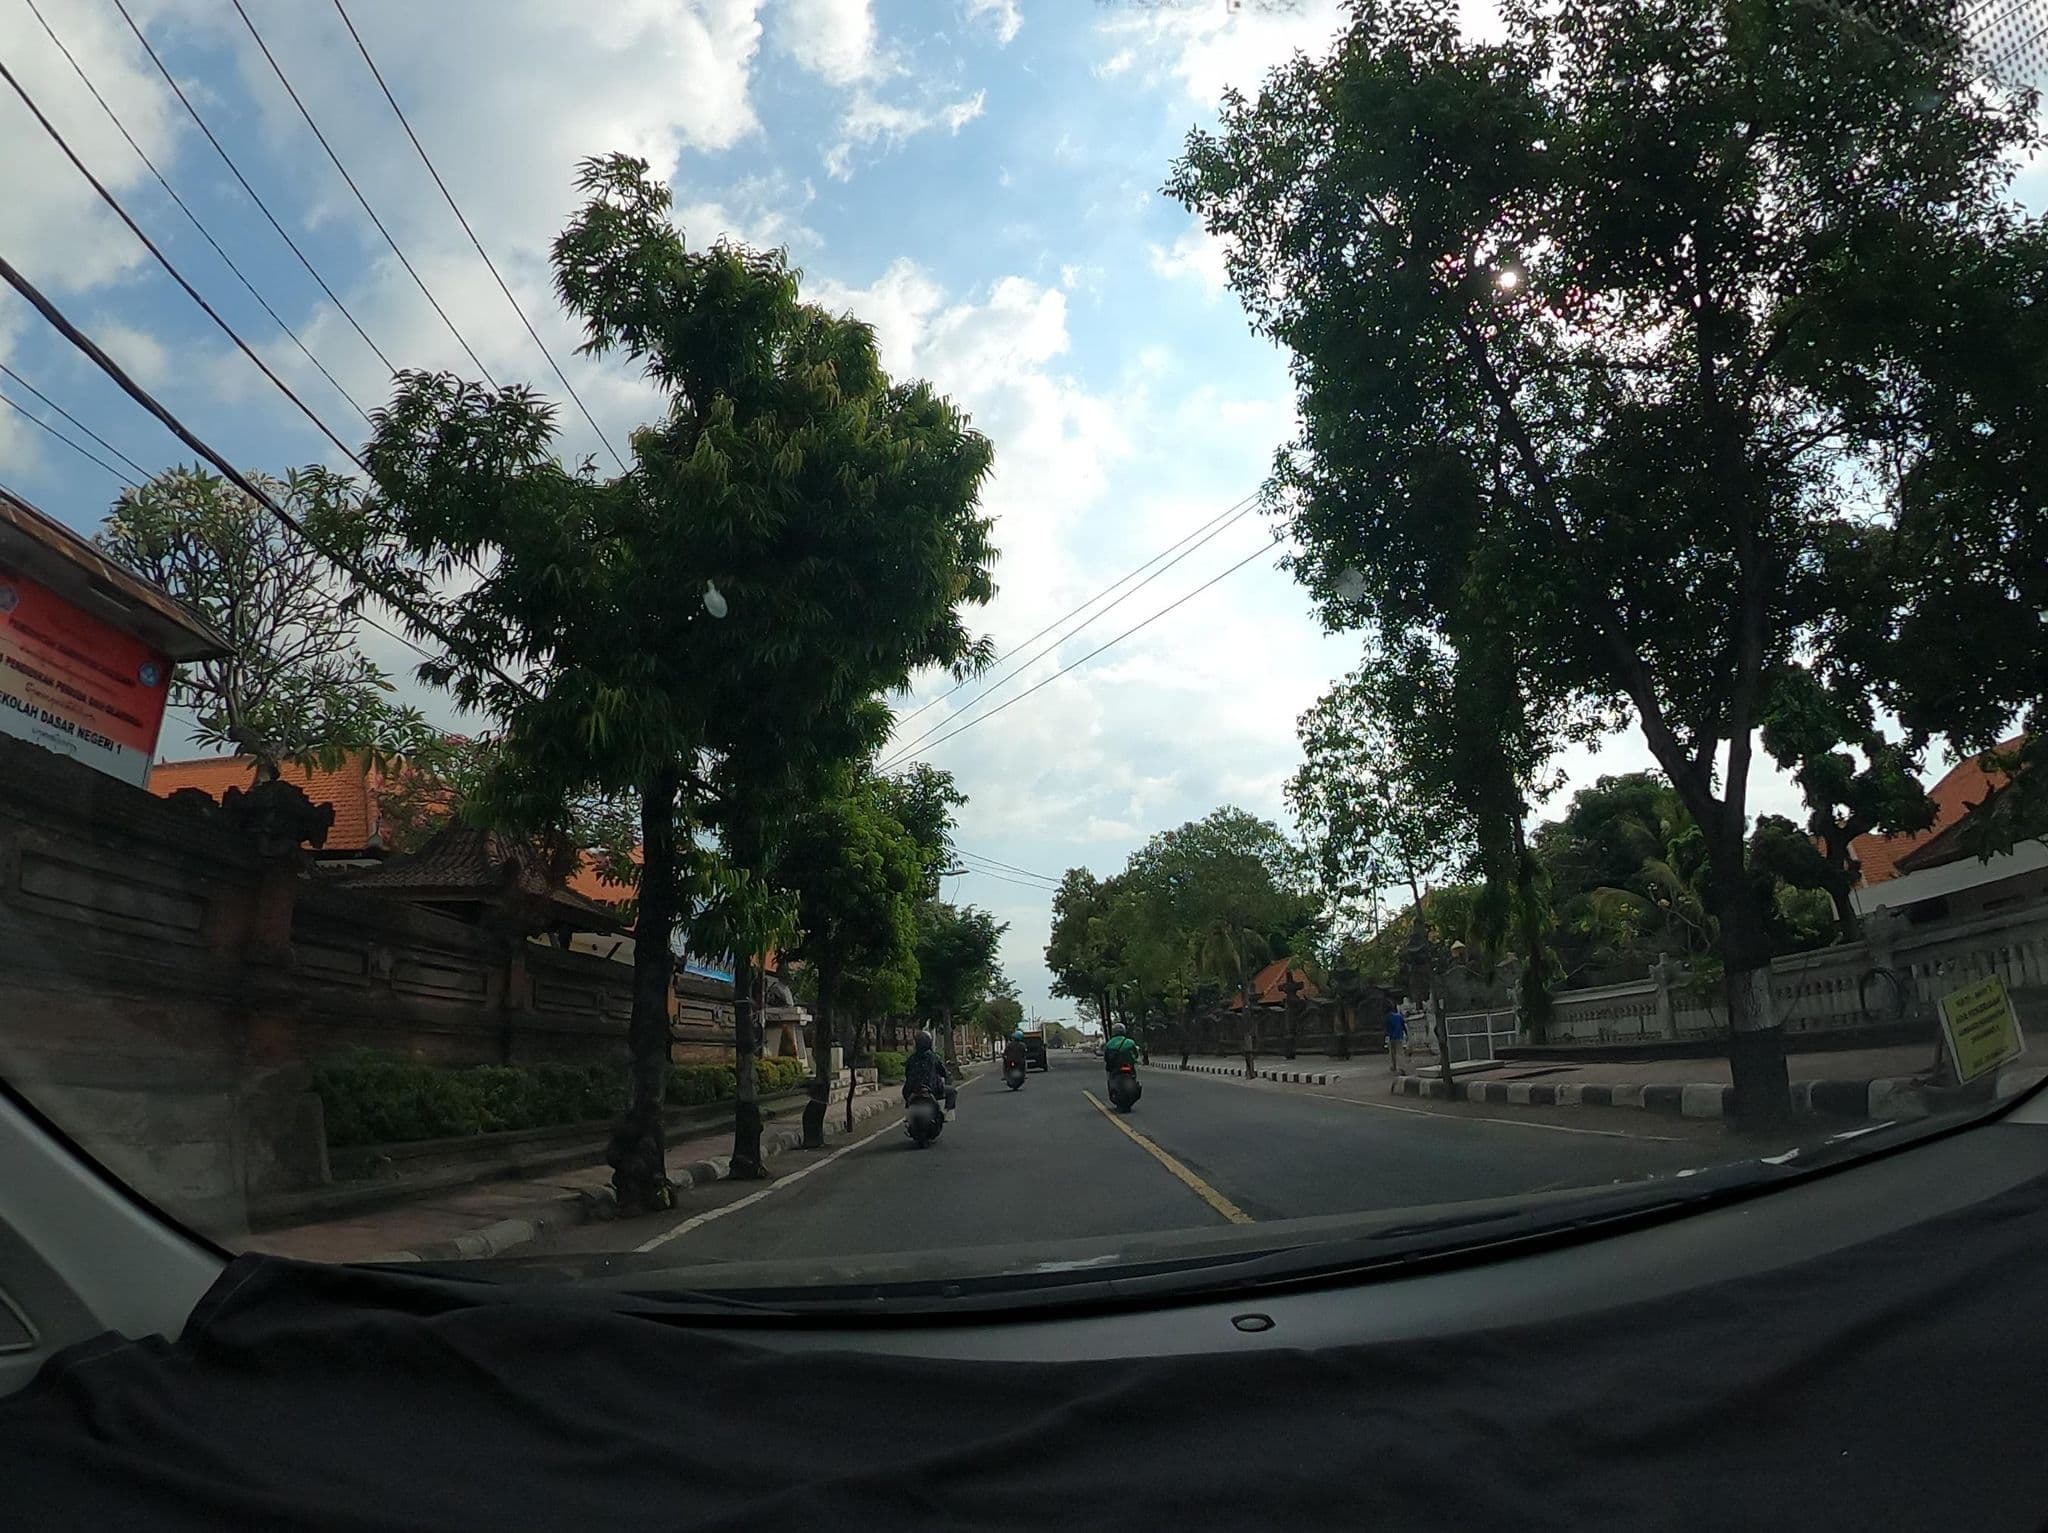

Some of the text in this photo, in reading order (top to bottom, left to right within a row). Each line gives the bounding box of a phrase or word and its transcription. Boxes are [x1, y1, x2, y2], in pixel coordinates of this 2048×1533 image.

[41, 710, 80, 735] DASAR
[77, 727, 114, 751] NEGERI
[115, 744, 122, 755] 1
